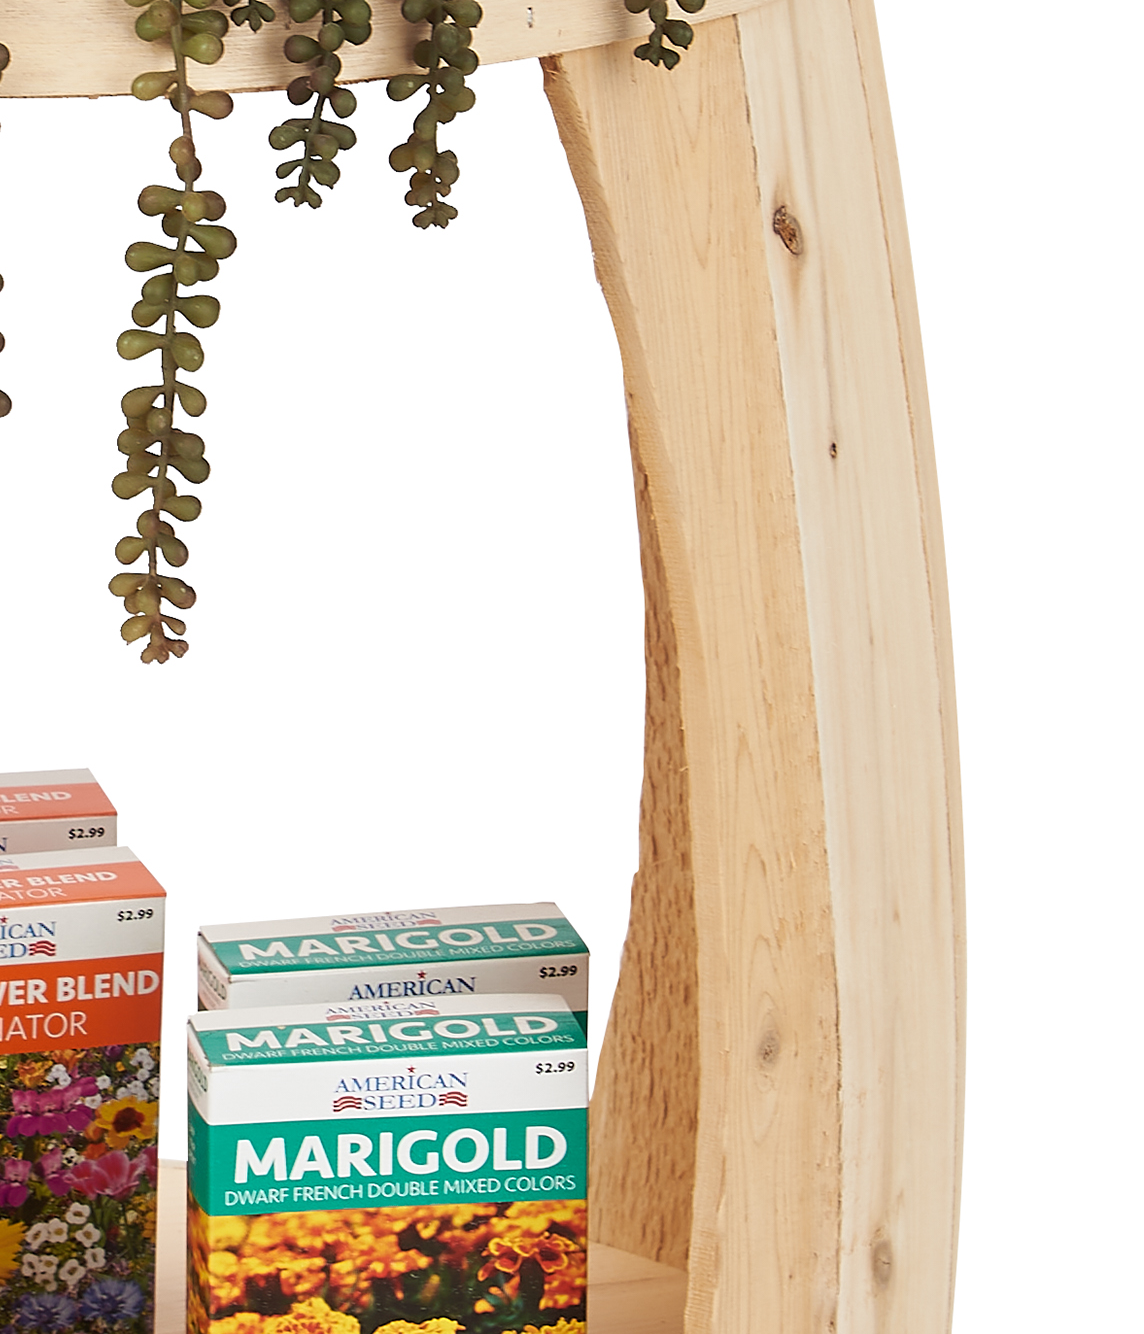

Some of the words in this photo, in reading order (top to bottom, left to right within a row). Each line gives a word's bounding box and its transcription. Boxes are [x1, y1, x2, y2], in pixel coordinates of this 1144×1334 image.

[68, 826, 105, 840] $2.99
[28, 871, 117, 886] BLEND
[117, 908, 154, 923] $2.99
[330, 912, 437, 925] AMERICAN
[238, 923, 558, 961] MARIGOLD
[239, 956, 299, 969] DWARF
[304, 952, 373, 965] FRENCH
[376, 948, 449, 961] DOUBLE
[452, 944, 504, 956] MIXED
[506, 938, 586, 950] COLORS
[539, 965, 578, 979] $2.99
[57, 970, 160, 1003] BLEND
[348, 977, 476, 1001] AMERICAN
[326, 1002, 436, 1014] AMERICAN
[226, 1015, 558, 1052] MARIGOLD
[222, 1049, 287, 1061] DWARF
[292, 1045, 365, 1058] FRENCH
[368, 1041, 438, 1054] DOUBLE
[442, 1037, 499, 1050] MIXED
[501, 1033, 575, 1046] COLORS
[535, 1061, 575, 1075] $2.99
[333, 1069, 468, 1094] AMERICAN
[363, 1092, 437, 1110] SEED
[234, 1125, 568, 1184] MARIGOLD
[225, 1188, 289, 1206] DWARF
[293, 1183, 363, 1202] FRENCH
[367, 1179, 439, 1198] DOUBLE
[442, 1176, 500, 1195] MIXED
[504, 1174, 576, 1192] COLORS
